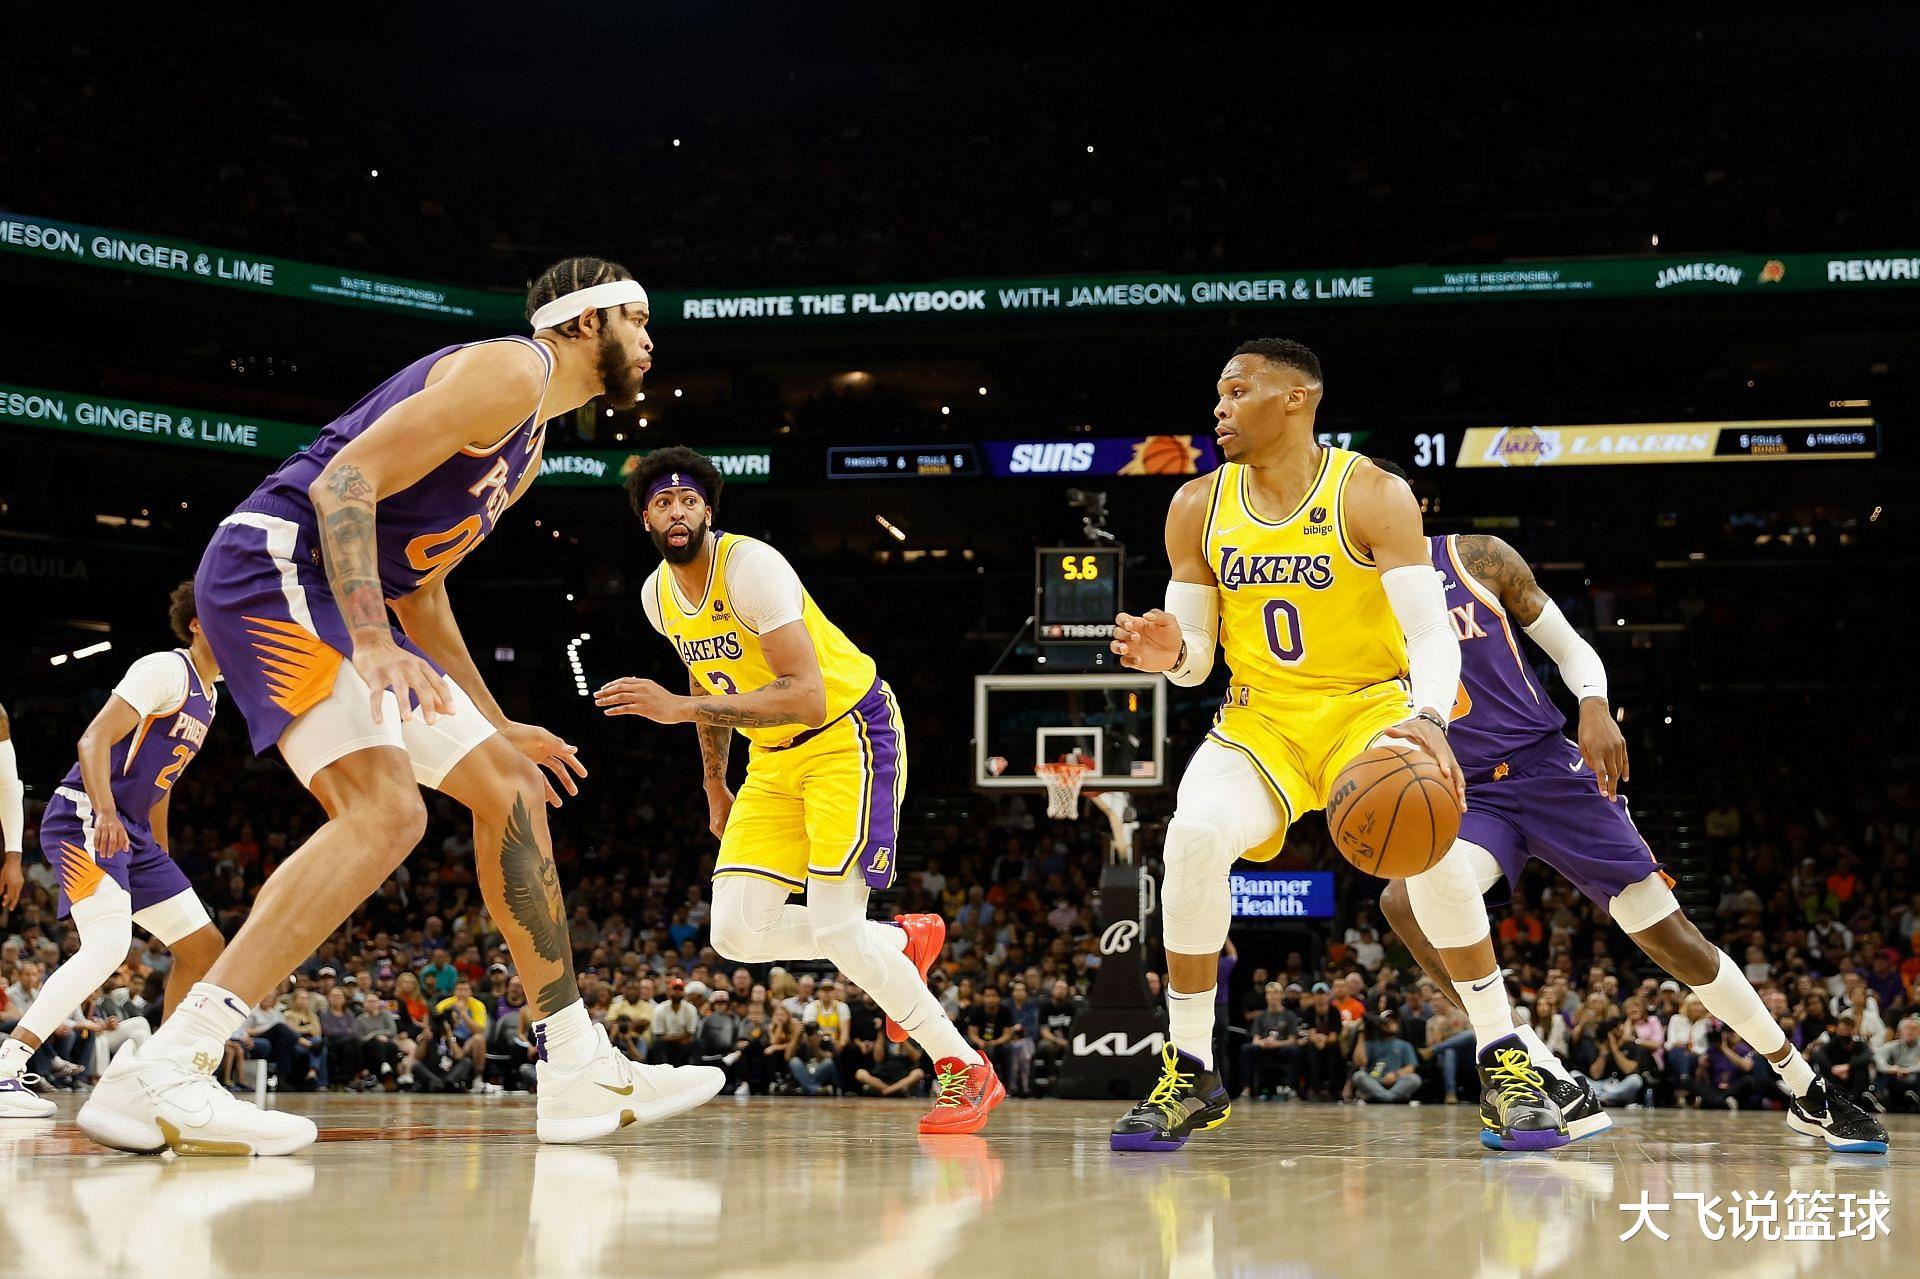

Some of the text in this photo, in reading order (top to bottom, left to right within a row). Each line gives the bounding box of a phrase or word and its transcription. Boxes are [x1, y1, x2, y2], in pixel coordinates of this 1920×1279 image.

[91, 236, 189, 272] GINGER
[193, 253, 212, 276] &
[217, 257, 275, 286] LIME
[1827, 257, 1920, 282] REWRI
[1655, 262, 1742, 289] JAMESON
[683, 276, 1375, 319] REWRITE THE PLAYBOOK WITH JAMESON, GINGER & LIME
[75, 401, 172, 436] GINGER
[176, 416, 196, 439] &
[201, 419, 258, 447] LIME
[1414, 433, 1446, 467] 31
[1570, 432, 1710, 455] LAKERS
[538, 455, 607, 478] AMESON
[1009, 442, 1096, 473] SUNS
[1303, 524, 1333, 536] bibigo
[1062, 555, 1098, 580] 5.6
[1220, 547, 1334, 591] LAKERS
[712, 612, 731, 622] bibigo
[1061, 624, 1116, 638] TISSOT
[1262, 598, 1305, 664] 0
[674, 631, 743, 666] LAKERS
[1230, 875, 1312, 896] Banner
